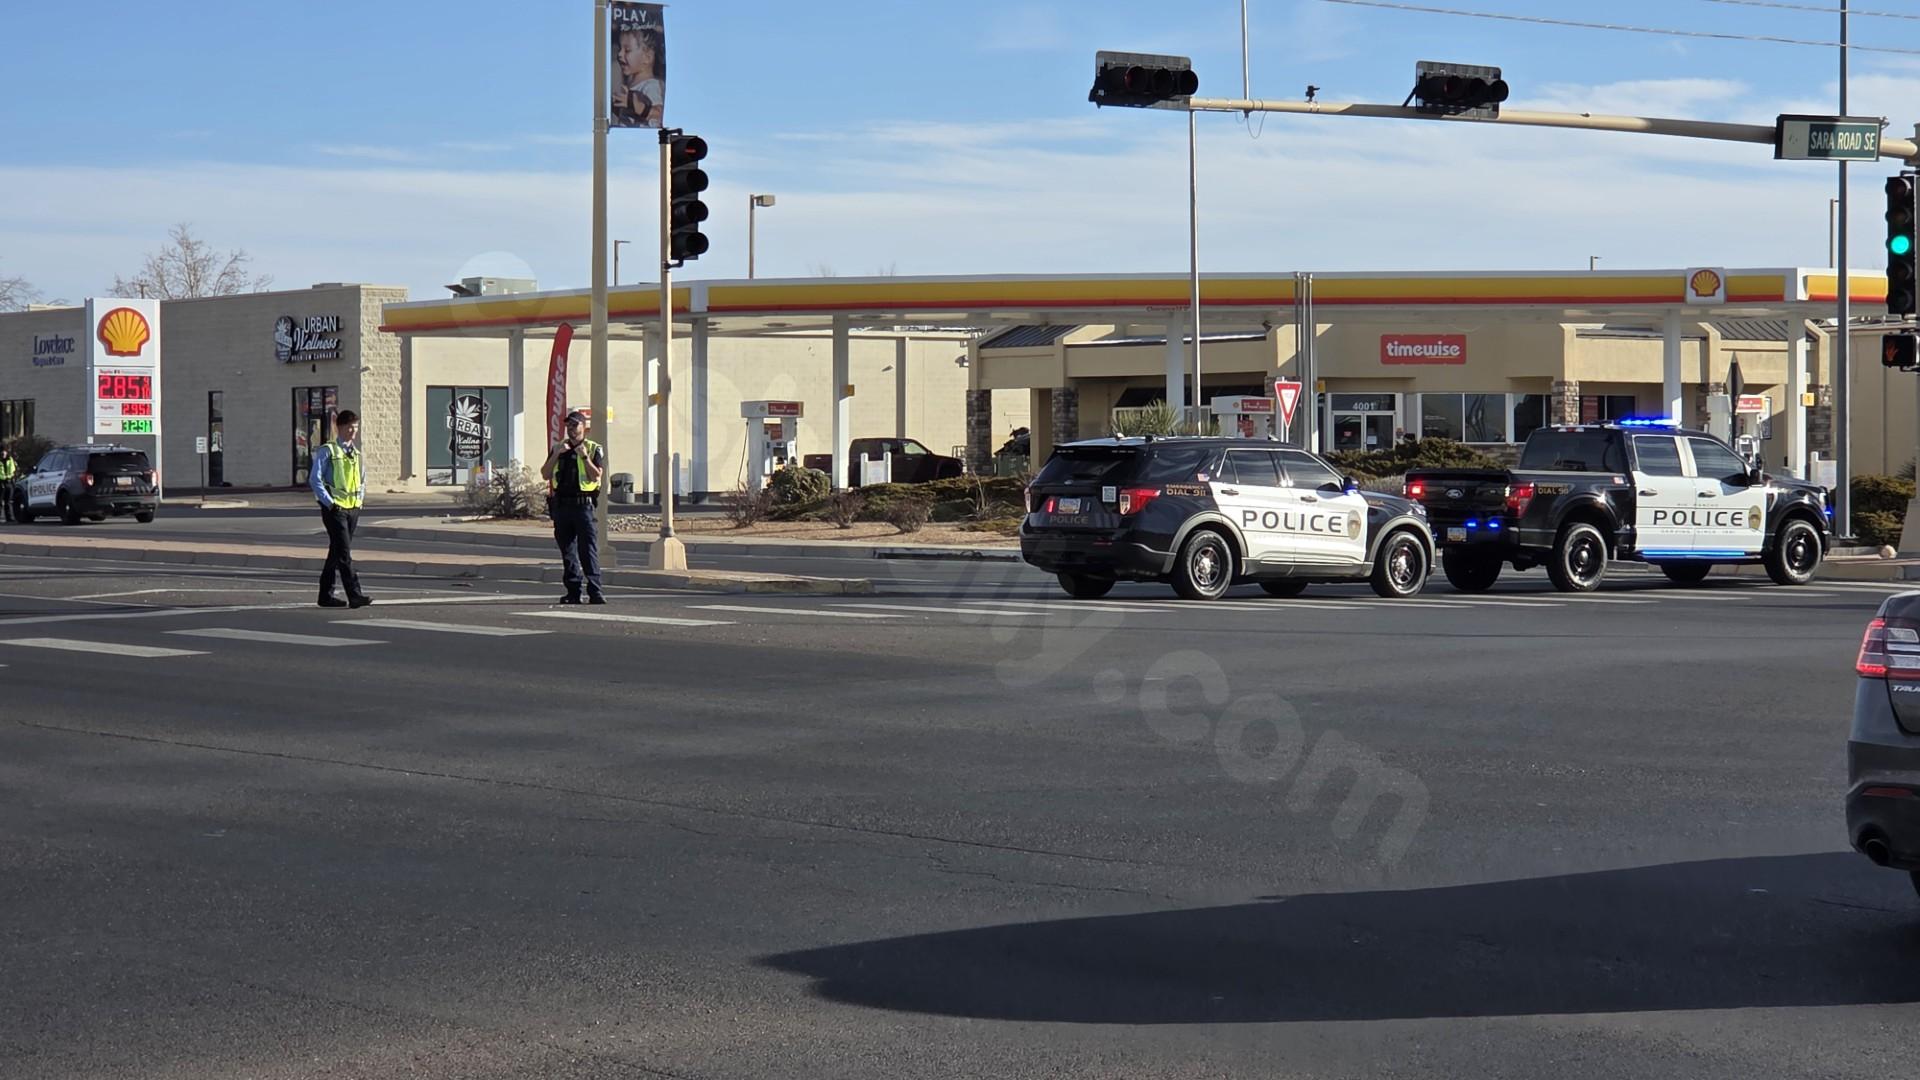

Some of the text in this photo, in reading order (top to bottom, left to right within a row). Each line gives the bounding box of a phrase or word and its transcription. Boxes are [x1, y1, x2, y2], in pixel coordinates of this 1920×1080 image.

[613, 8, 647, 22] PLAY
[1810, 131, 1876, 150] SARA ROAD SE
[303, 316, 337, 333] URBAN
[34, 334, 75, 355] Lovelace
[294, 327, 338, 351] Wellness
[1386, 340, 1461, 357] timewise
[99, 376, 140, 399] 2.85
[1352, 402, 1375, 411] 4001
[33, 483, 57, 495] POLICE
[1166, 488, 1207, 497] DIAL 911
[1538, 487, 1557, 495] DIAL
[1050, 515, 1089, 525] POLICE
[1242, 509, 1342, 534] POLICE
[1653, 510, 1743, 527] POLICE
